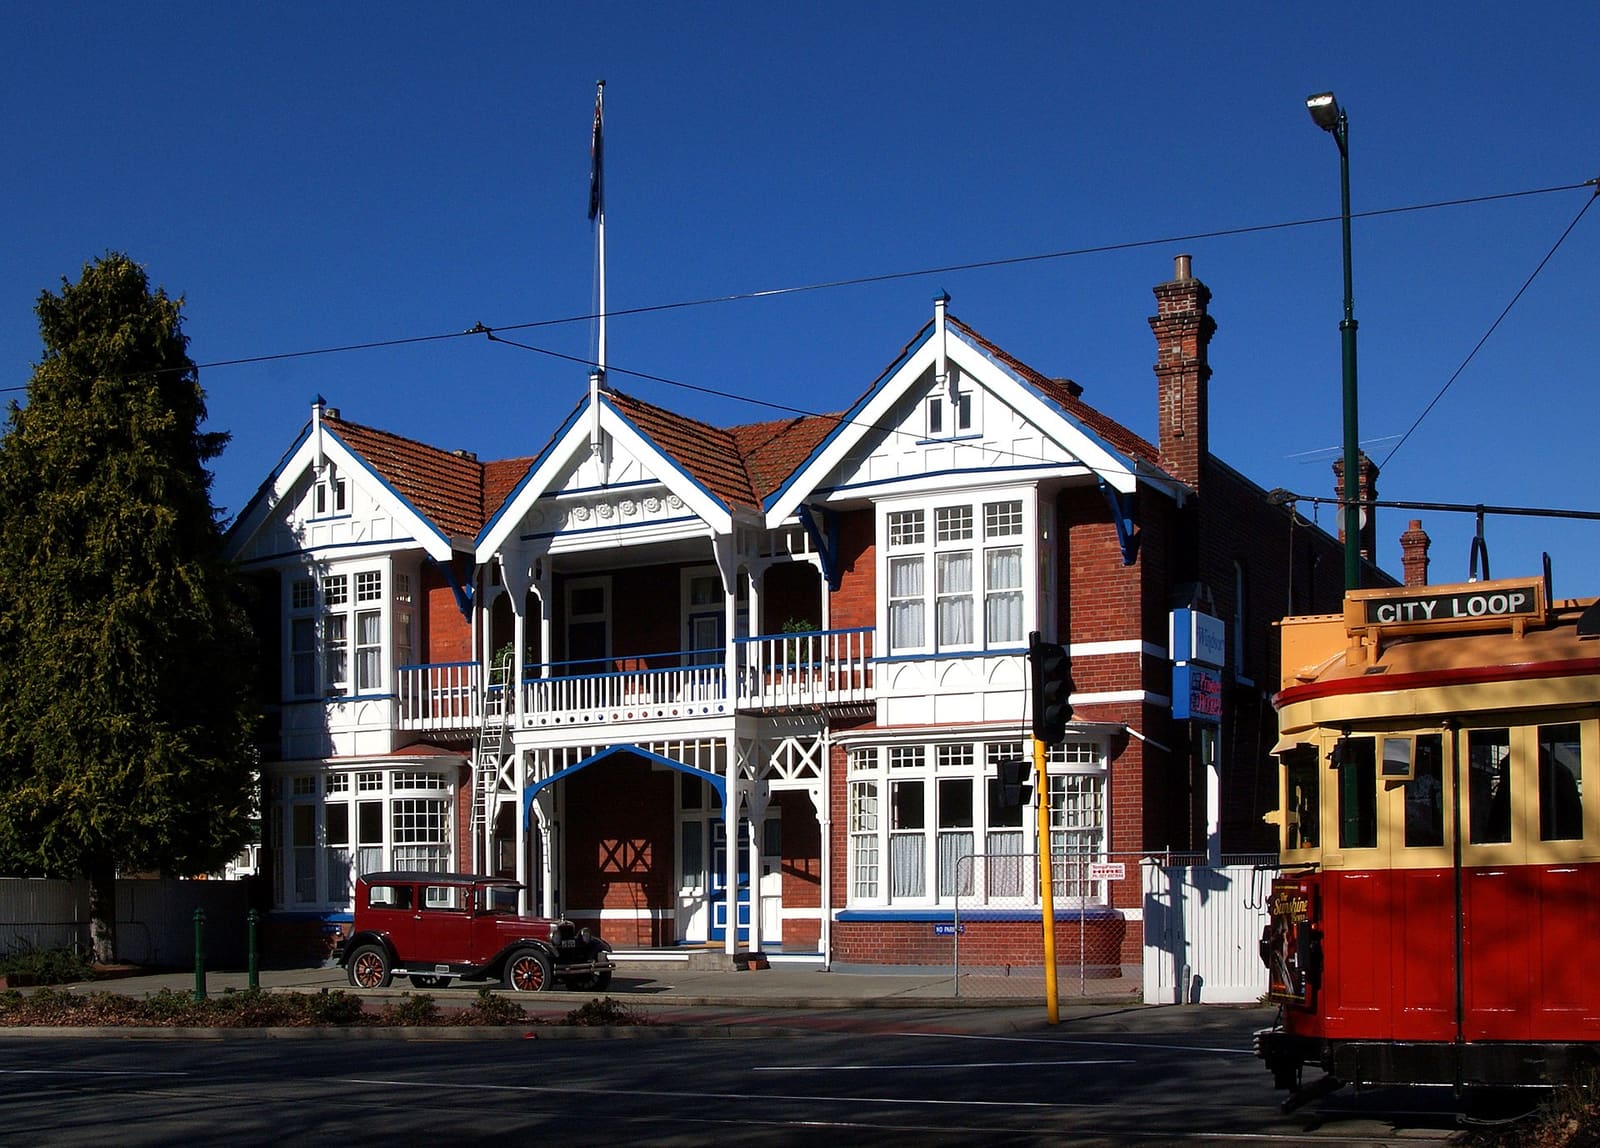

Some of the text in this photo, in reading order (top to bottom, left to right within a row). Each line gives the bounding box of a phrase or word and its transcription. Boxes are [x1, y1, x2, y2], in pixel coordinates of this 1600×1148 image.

[1376, 592, 1526, 624] CITY LOOP
[1273, 896, 1308, 916] Sunshine
